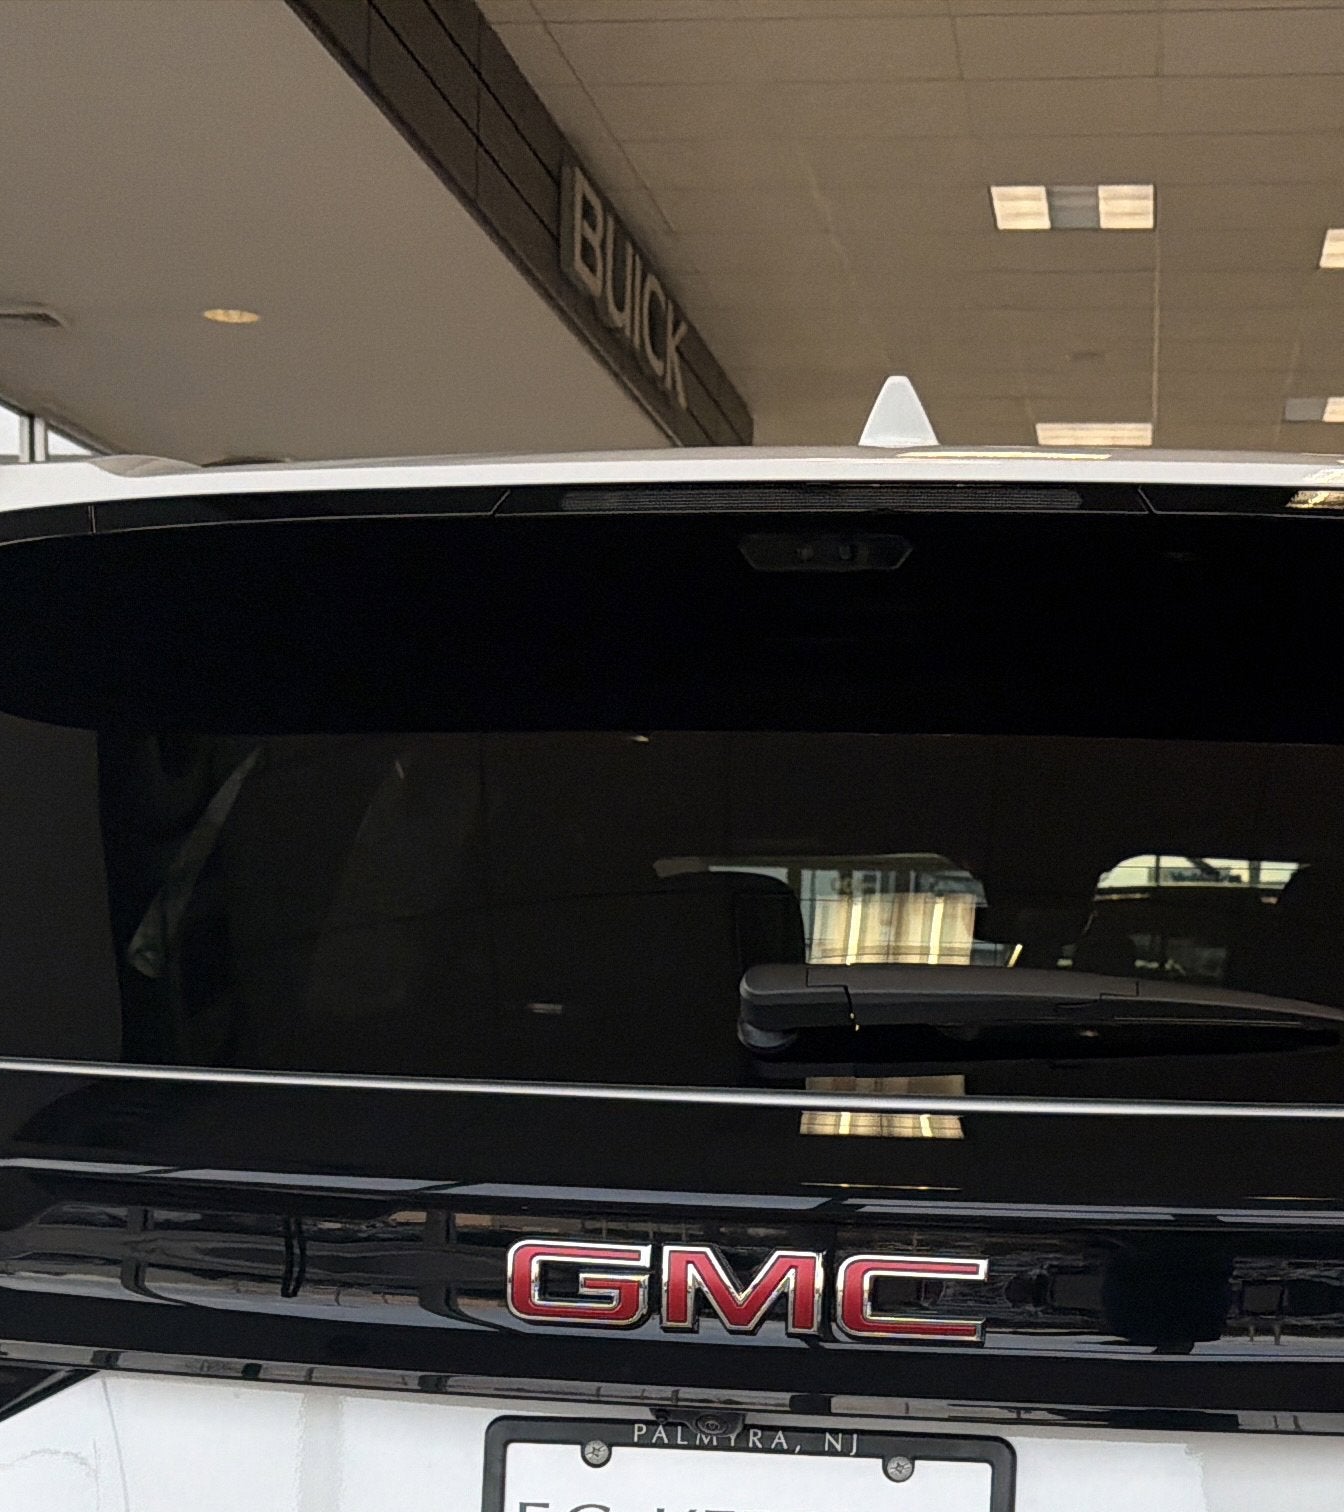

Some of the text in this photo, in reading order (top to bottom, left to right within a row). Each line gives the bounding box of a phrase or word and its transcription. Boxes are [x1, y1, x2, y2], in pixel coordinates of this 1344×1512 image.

[570, 164, 688, 411] BUICK
[506, 1238, 989, 1347] GMC
[824, 1431, 859, 1456] NJ
